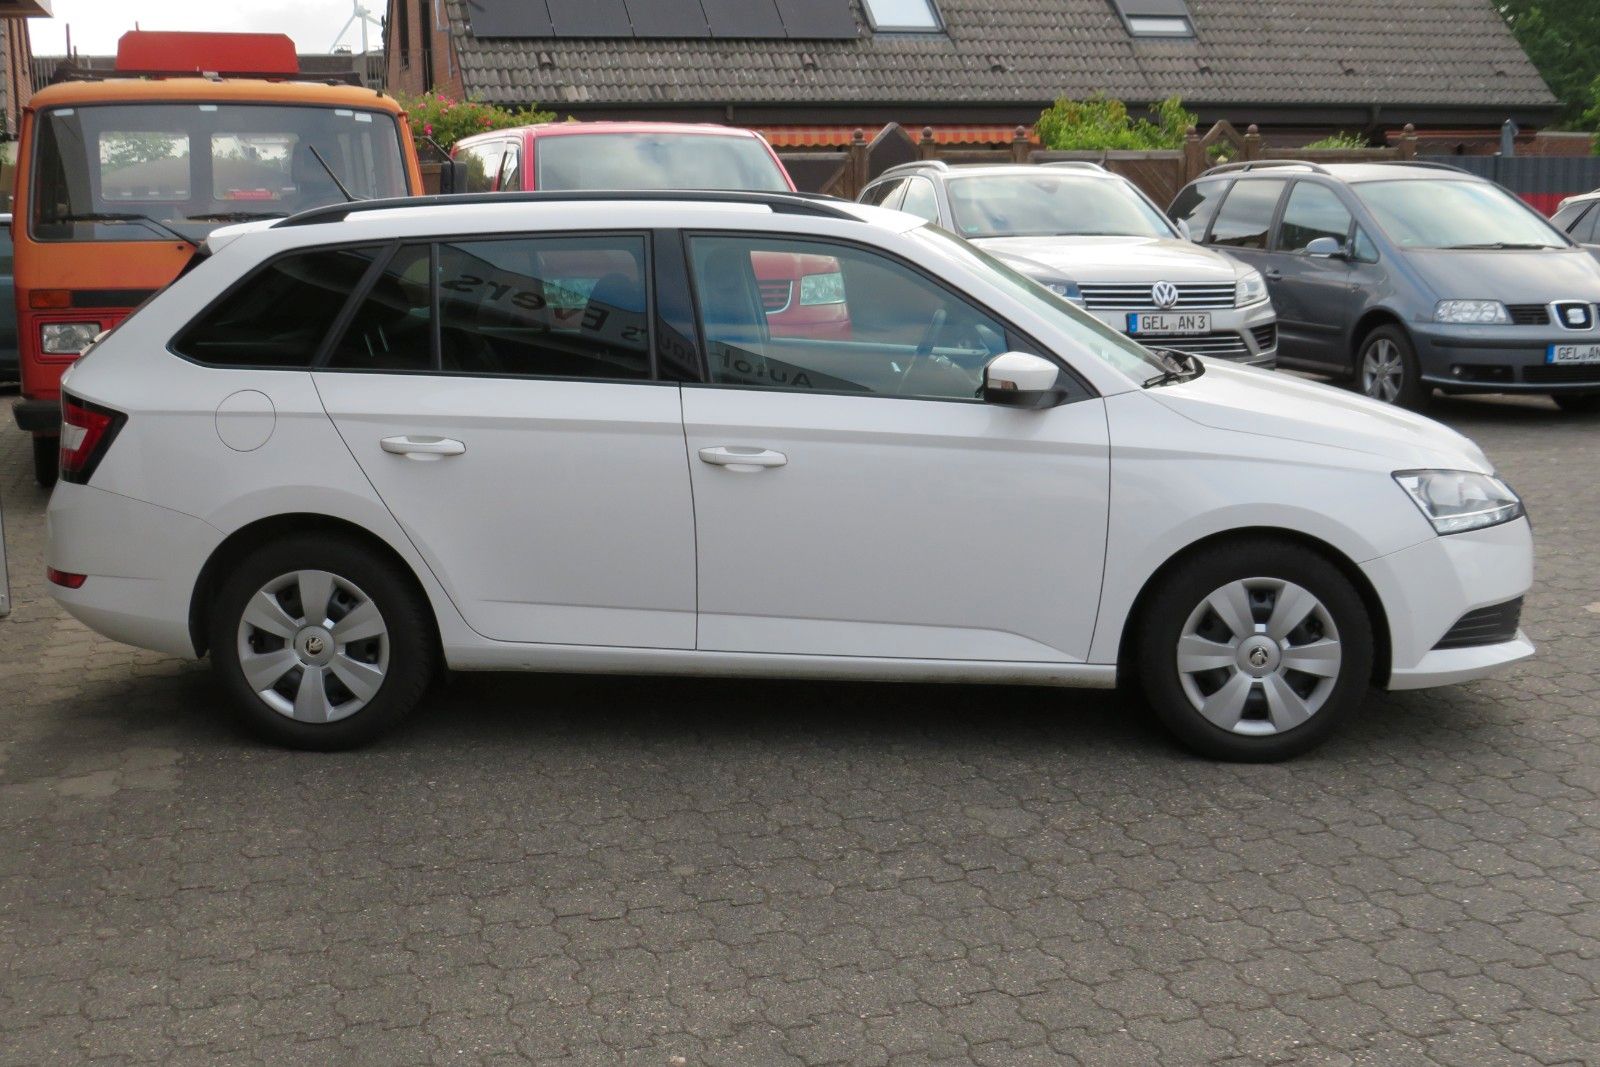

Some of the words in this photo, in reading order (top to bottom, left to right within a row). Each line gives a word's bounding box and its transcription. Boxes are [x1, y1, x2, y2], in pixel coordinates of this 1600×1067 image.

[1152, 280, 1178, 308] VW
[1142, 316, 1169, 330] GEL
[1178, 315, 1195, 330] AN
[1198, 315, 1206, 330] 3
[1558, 347, 1580, 360] GEL
